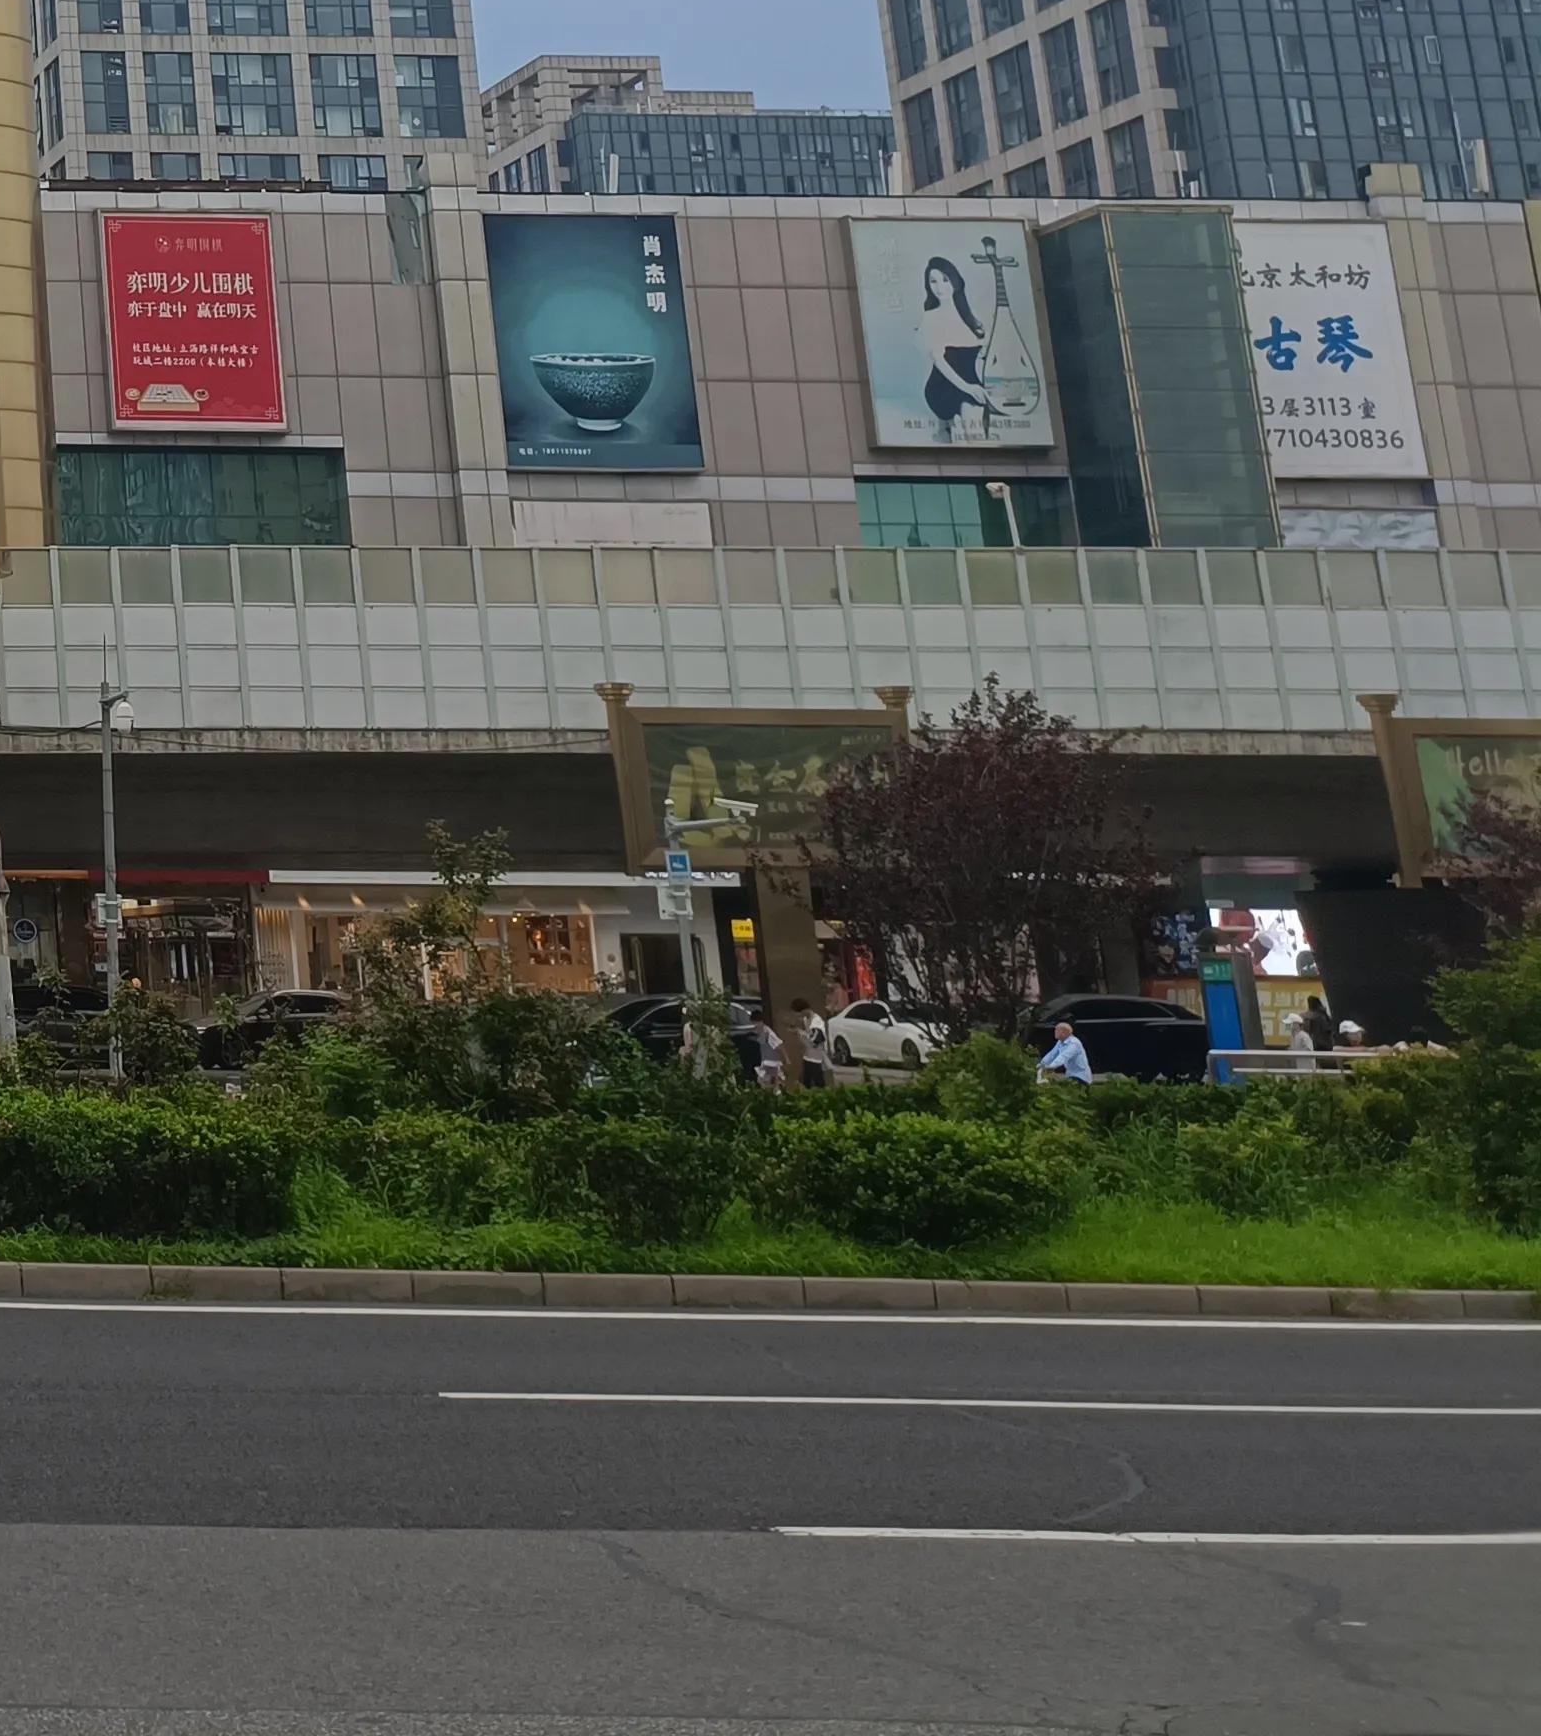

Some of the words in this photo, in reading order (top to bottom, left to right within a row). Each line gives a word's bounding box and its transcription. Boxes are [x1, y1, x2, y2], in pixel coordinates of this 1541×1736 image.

[127, 270, 254, 296] 弈明少儿围棋
[643, 235, 667, 313] 肖杰明
[196, 302, 258, 319] 赢在明天
[1253, 315, 1374, 373] 古琴
[1267, 428, 1404, 450] 710430836
